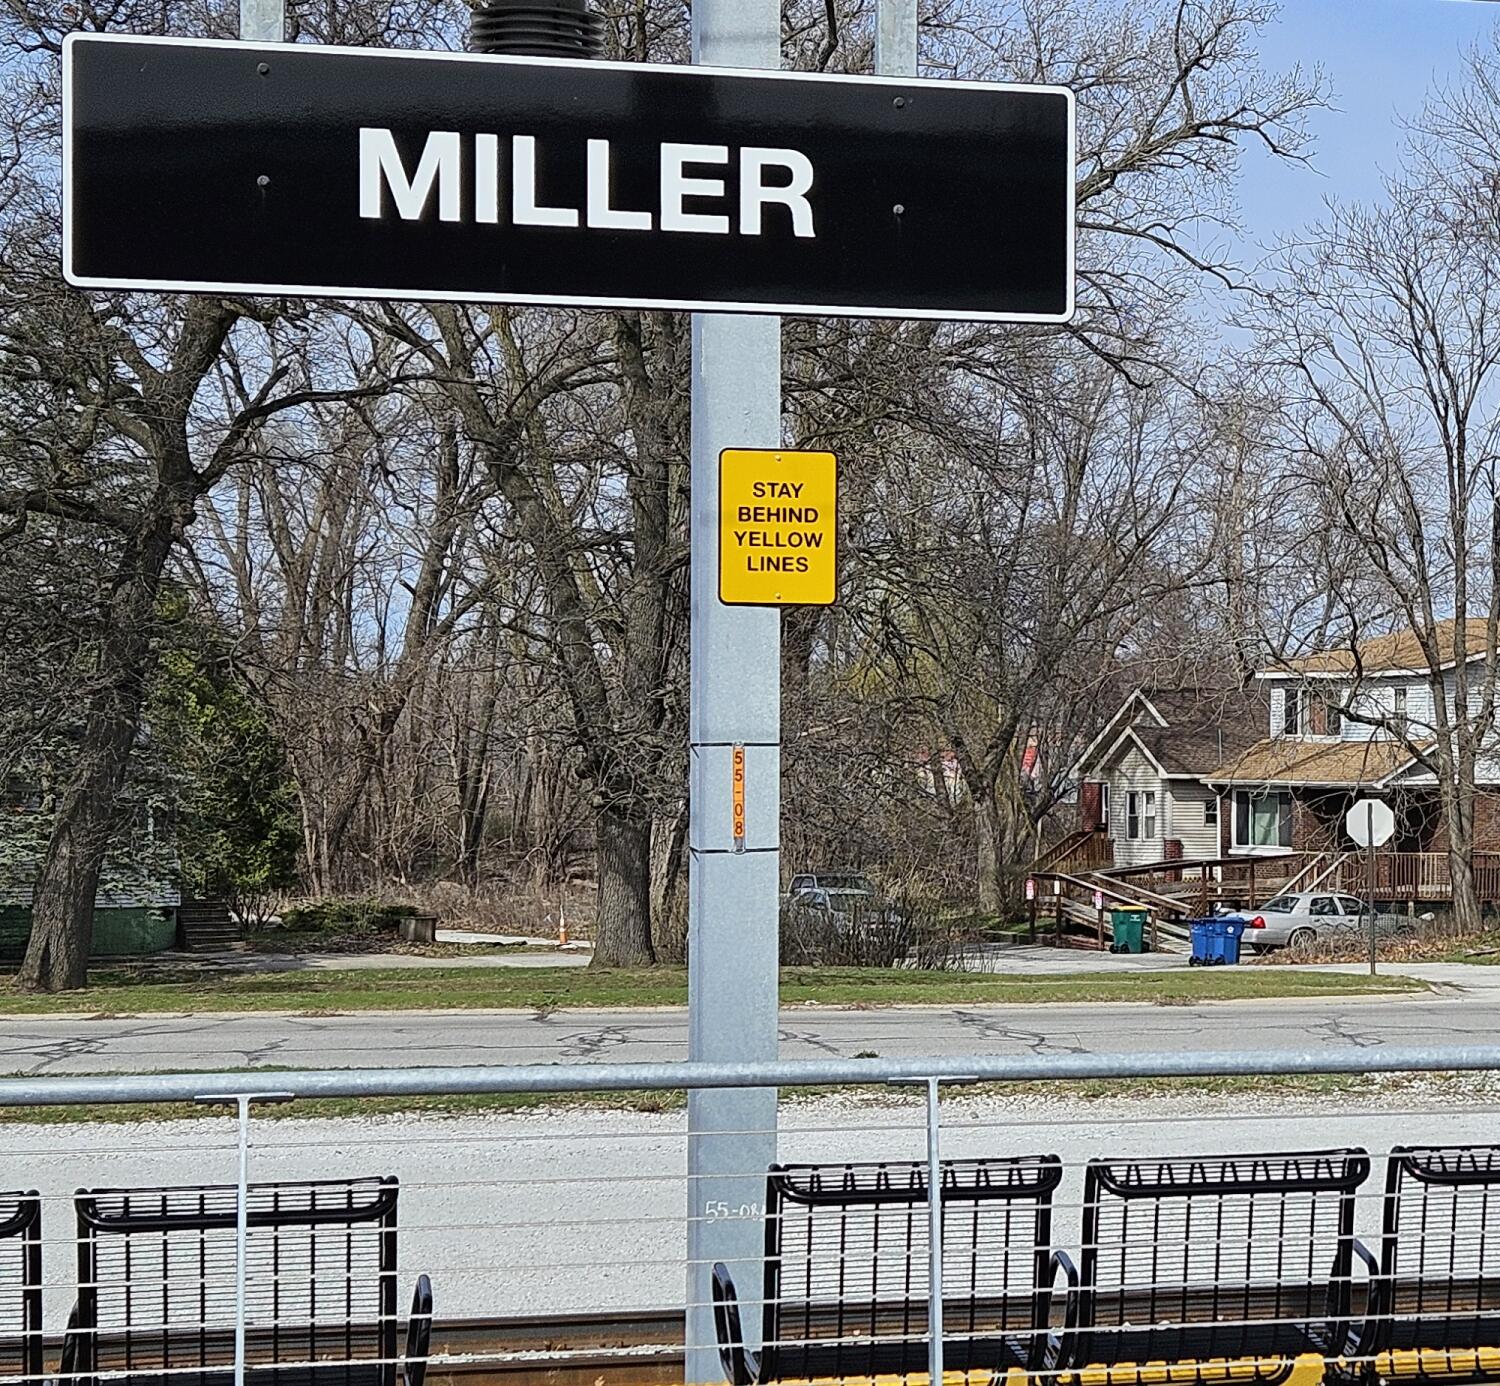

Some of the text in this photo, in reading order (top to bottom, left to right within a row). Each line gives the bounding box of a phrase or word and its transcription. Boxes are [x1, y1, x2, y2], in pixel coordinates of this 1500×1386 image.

[360, 128, 816, 238] MILLER
[752, 481, 804, 499] STAY
[738, 506, 819, 524] BEHIND
[734, 531, 823, 549] YELLOW
[747, 556, 809, 573] LINES
[733, 750, 744, 836] 55-08
